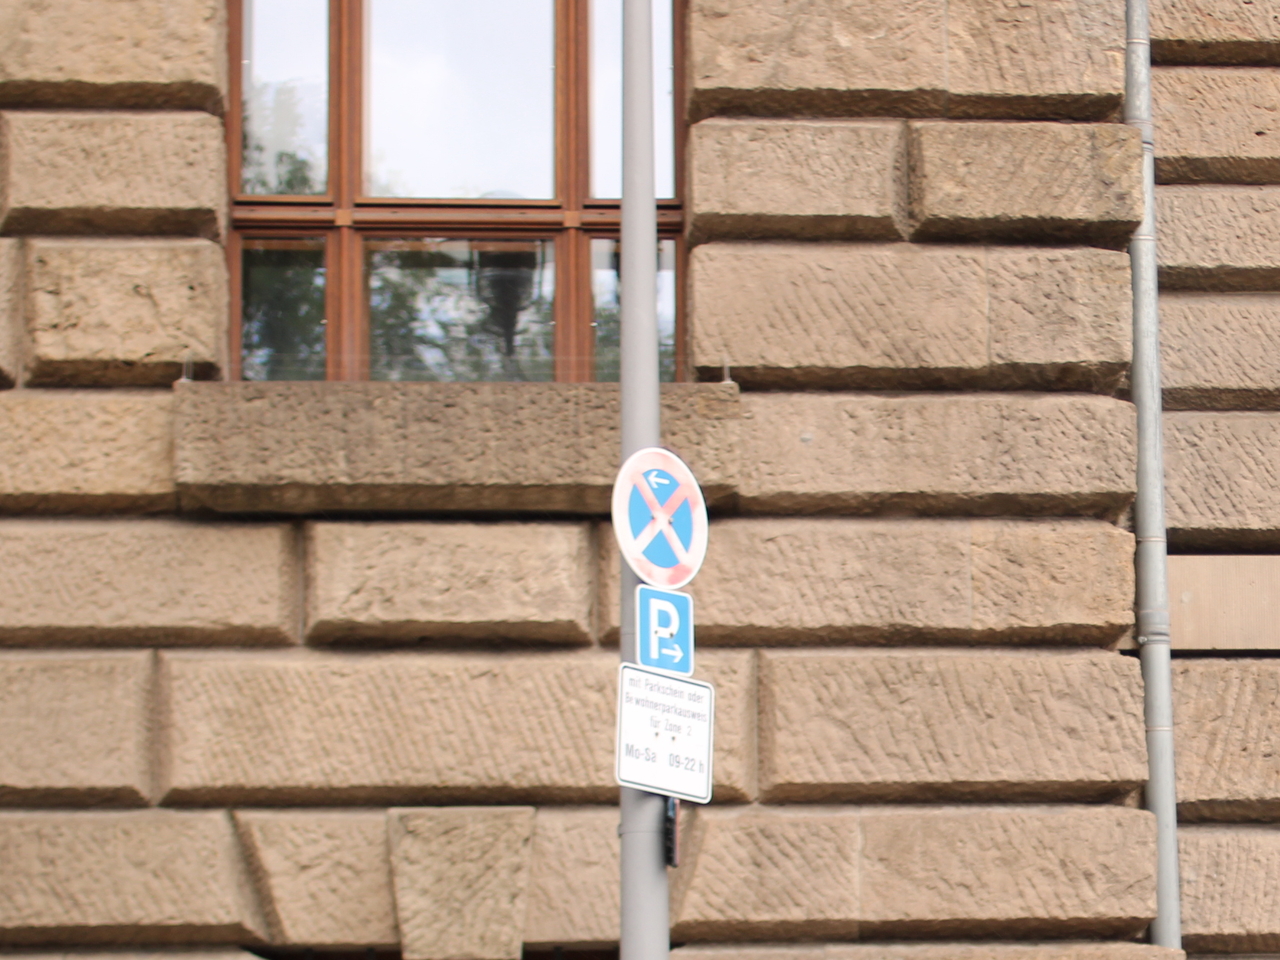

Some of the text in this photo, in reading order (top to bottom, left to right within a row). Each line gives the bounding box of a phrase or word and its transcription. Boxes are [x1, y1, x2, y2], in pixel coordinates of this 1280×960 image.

[649, 597, 680, 660] P
[645, 678, 685, 699] Parkschein
[688, 690, 705, 704] oder
[650, 715, 692, 737] für Zone 2
[625, 743, 705, 774] Mo-Sa 09-22 h
